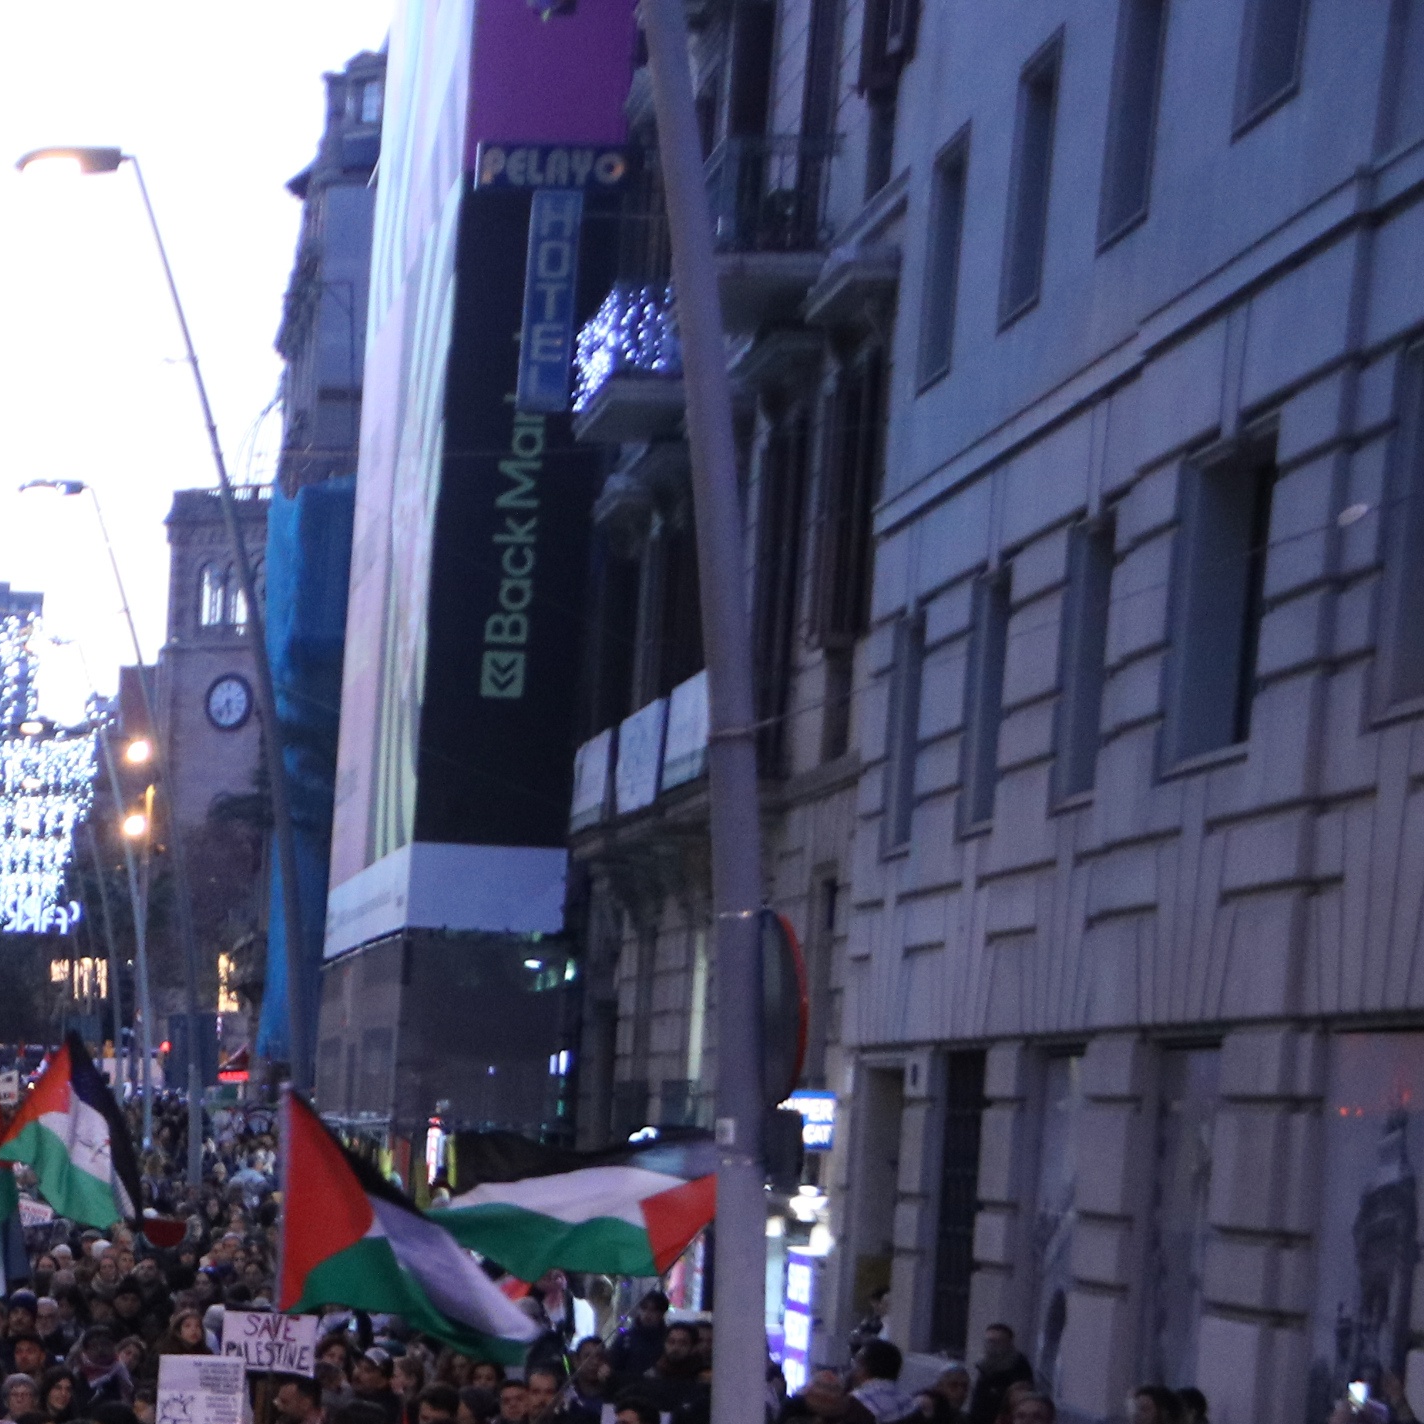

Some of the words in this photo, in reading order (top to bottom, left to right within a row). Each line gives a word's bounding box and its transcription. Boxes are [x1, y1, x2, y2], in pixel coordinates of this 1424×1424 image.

[481, 146, 625, 186] PELAYO
[527, 199, 573, 401] HOTEL
[494, 398, 547, 508] Mar
[483, 516, 538, 645] Back
[244, 1313, 300, 1342] SAVE
